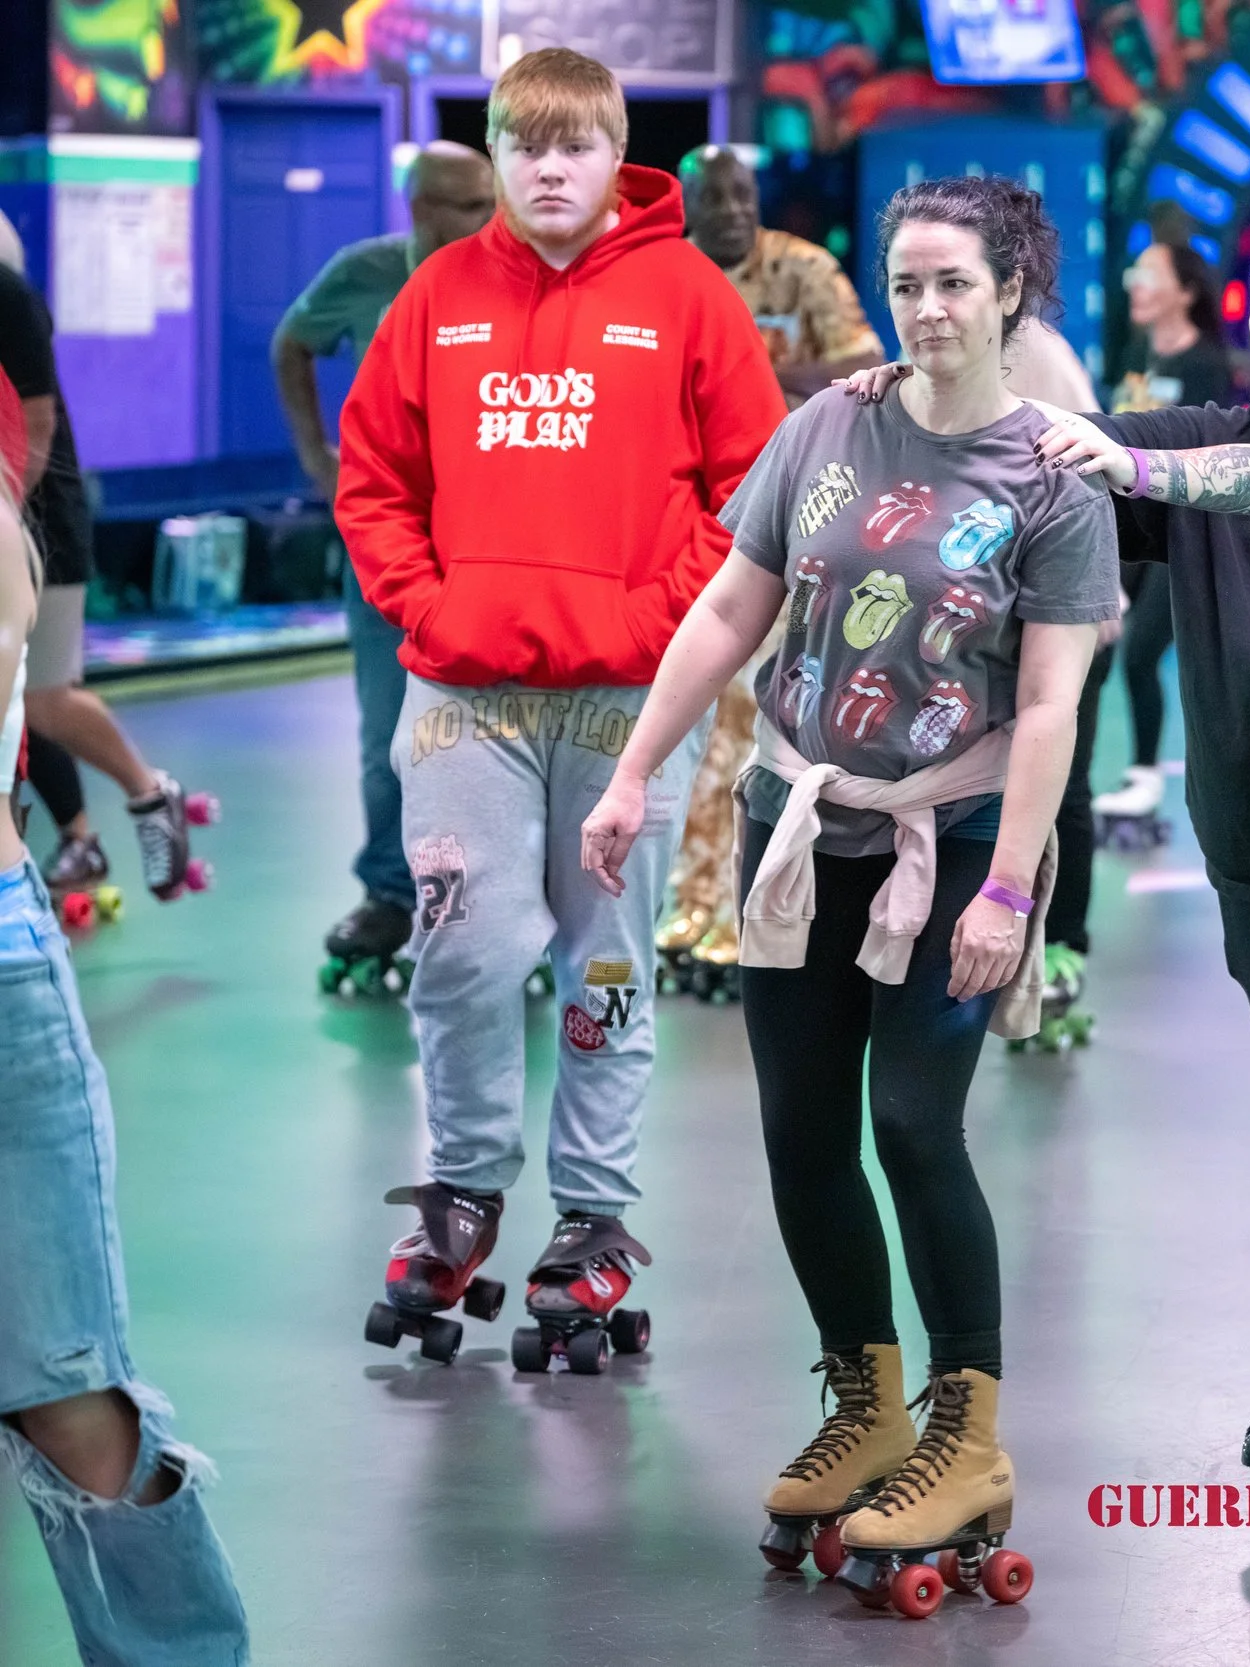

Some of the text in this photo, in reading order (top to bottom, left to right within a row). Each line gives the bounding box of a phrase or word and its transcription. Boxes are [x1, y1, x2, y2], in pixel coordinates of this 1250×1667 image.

[436, 335, 451, 346] NO
[438, 322, 492, 336] GOD GOT ME
[603, 333, 658, 350] BLESSINGS
[606, 324, 657, 339] COUNT MY
[478, 367, 596, 408] GOD'S
[476, 410, 593, 451] PLAN
[411, 700, 463, 767] NO
[416, 868, 469, 933] 21
[597, 986, 637, 1028] N
[453, 1197, 485, 1217] VNLA
